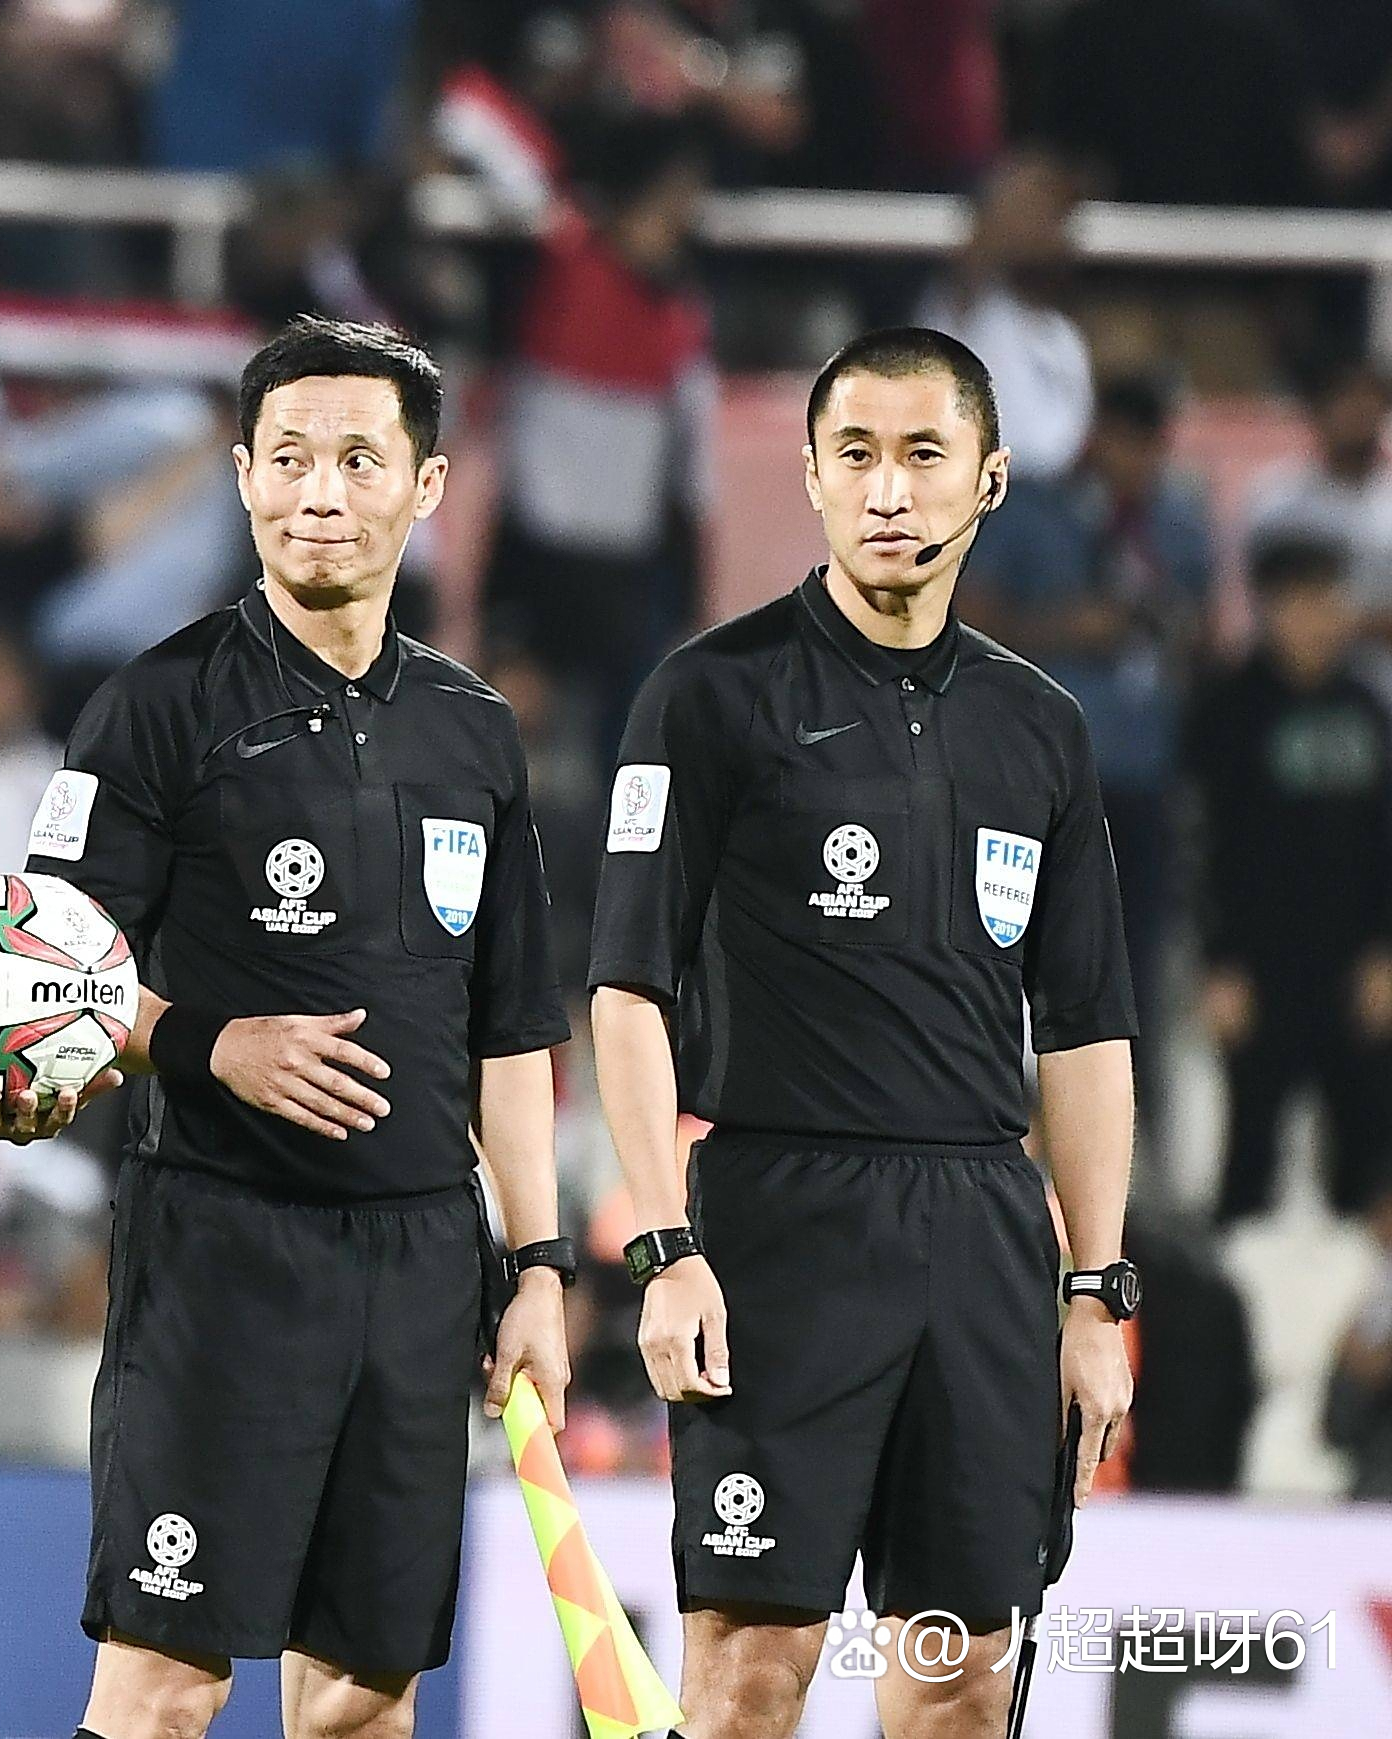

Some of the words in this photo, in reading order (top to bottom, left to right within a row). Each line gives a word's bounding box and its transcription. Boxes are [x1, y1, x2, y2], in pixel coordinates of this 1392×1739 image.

[433, 827, 480, 858] FIFA
[987, 839, 1033, 873] FIFA
[837, 883, 864, 896] AFC
[984, 882, 1030, 906] REFEREE
[279, 898, 307, 911] AFC
[808, 893, 857, 908] ASIAN
[859, 895, 890, 909] CUP
[250, 907, 300, 923] ASIAN
[302, 911, 337, 925] CUP
[31, 979, 124, 1005] molten
[745, 1536, 776, 1550] CUP
[172, 1579, 204, 1595] CUP
